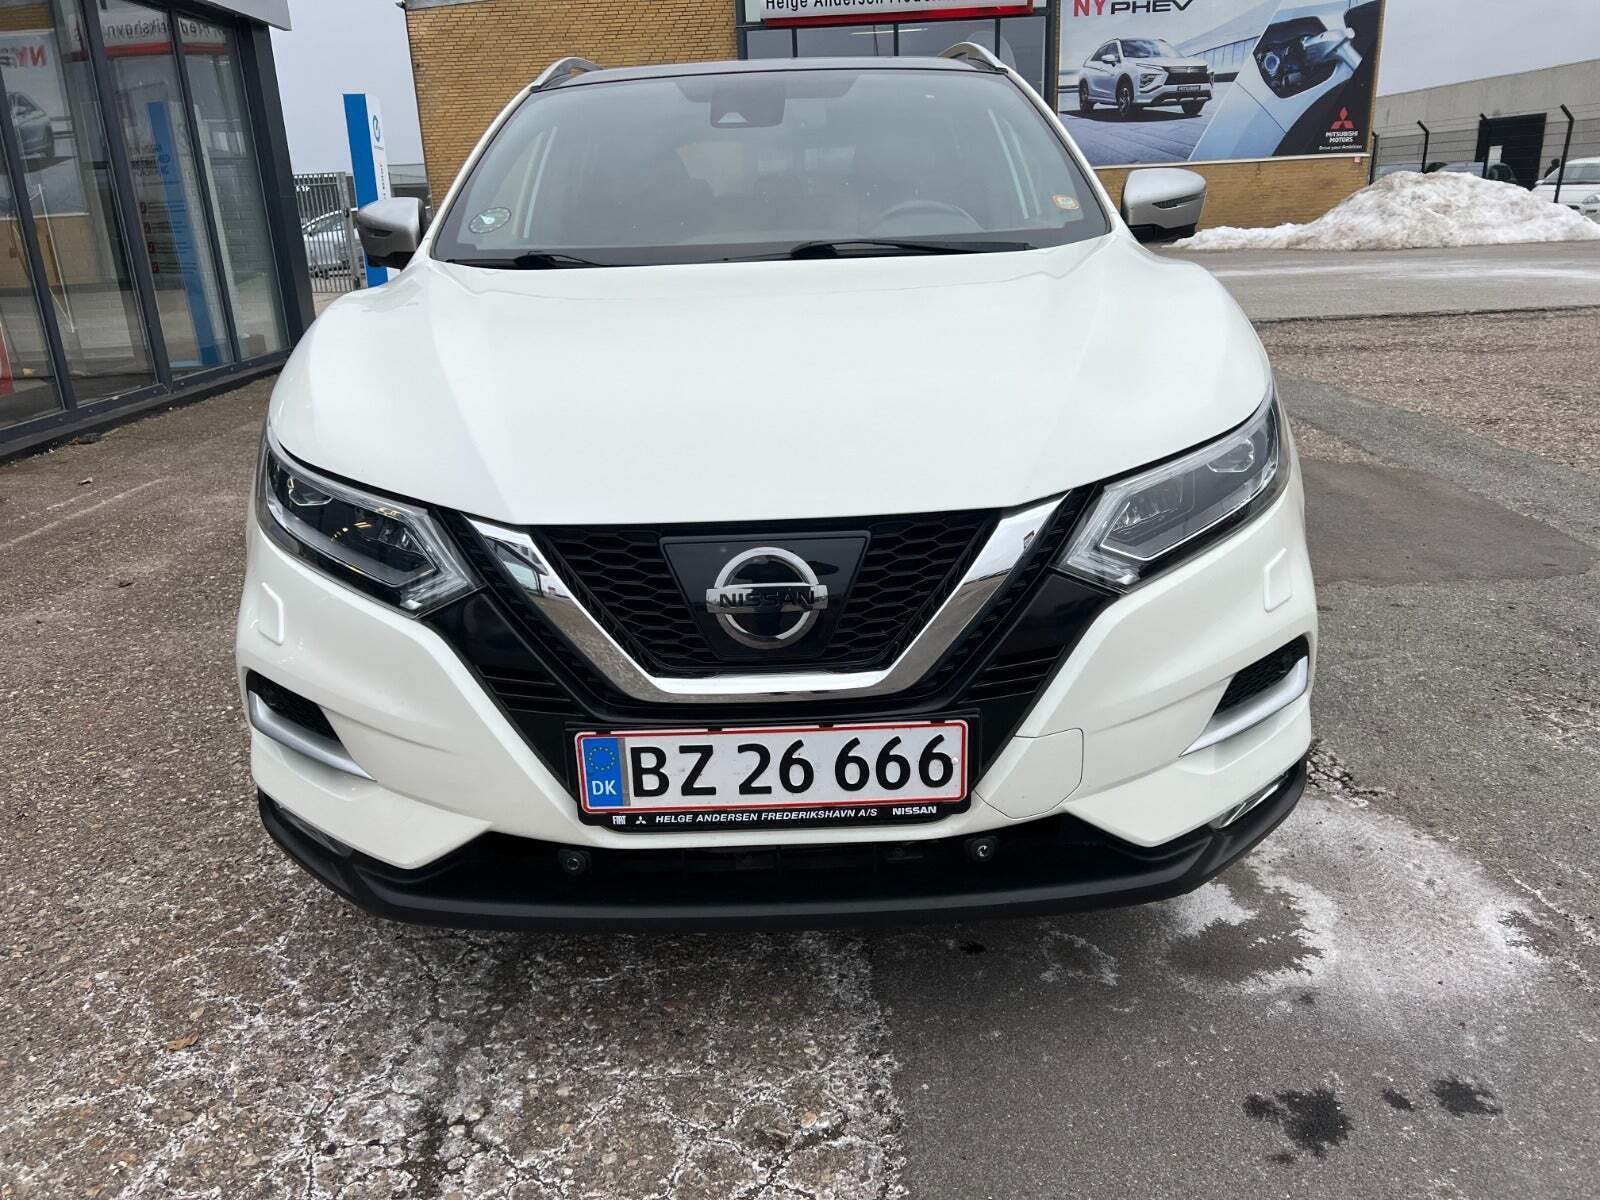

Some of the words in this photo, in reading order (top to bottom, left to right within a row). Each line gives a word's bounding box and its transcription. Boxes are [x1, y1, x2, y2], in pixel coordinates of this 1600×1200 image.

[766, 0, 808, 11] Helge
[1073, 0, 1106, 17] NY
[1110, 0, 1194, 15] PHEV
[1325, 130, 1359, 138] MITSUBISHI
[719, 590, 815, 609] NISSAN
[629, 743, 718, 798] BZ
[737, 739, 816, 795] 26
[834, 734, 955, 792] 666
[591, 780, 616, 796] DK
[655, 814, 694, 823] HELGE
[696, 812, 758, 822] ANDERSEN
[761, 810, 855, 821] FREDERIKSHAVN
[858, 808, 878, 818] A/S
[892, 806, 937, 816] NISSAN
[612, 815, 627, 825] FIAT
